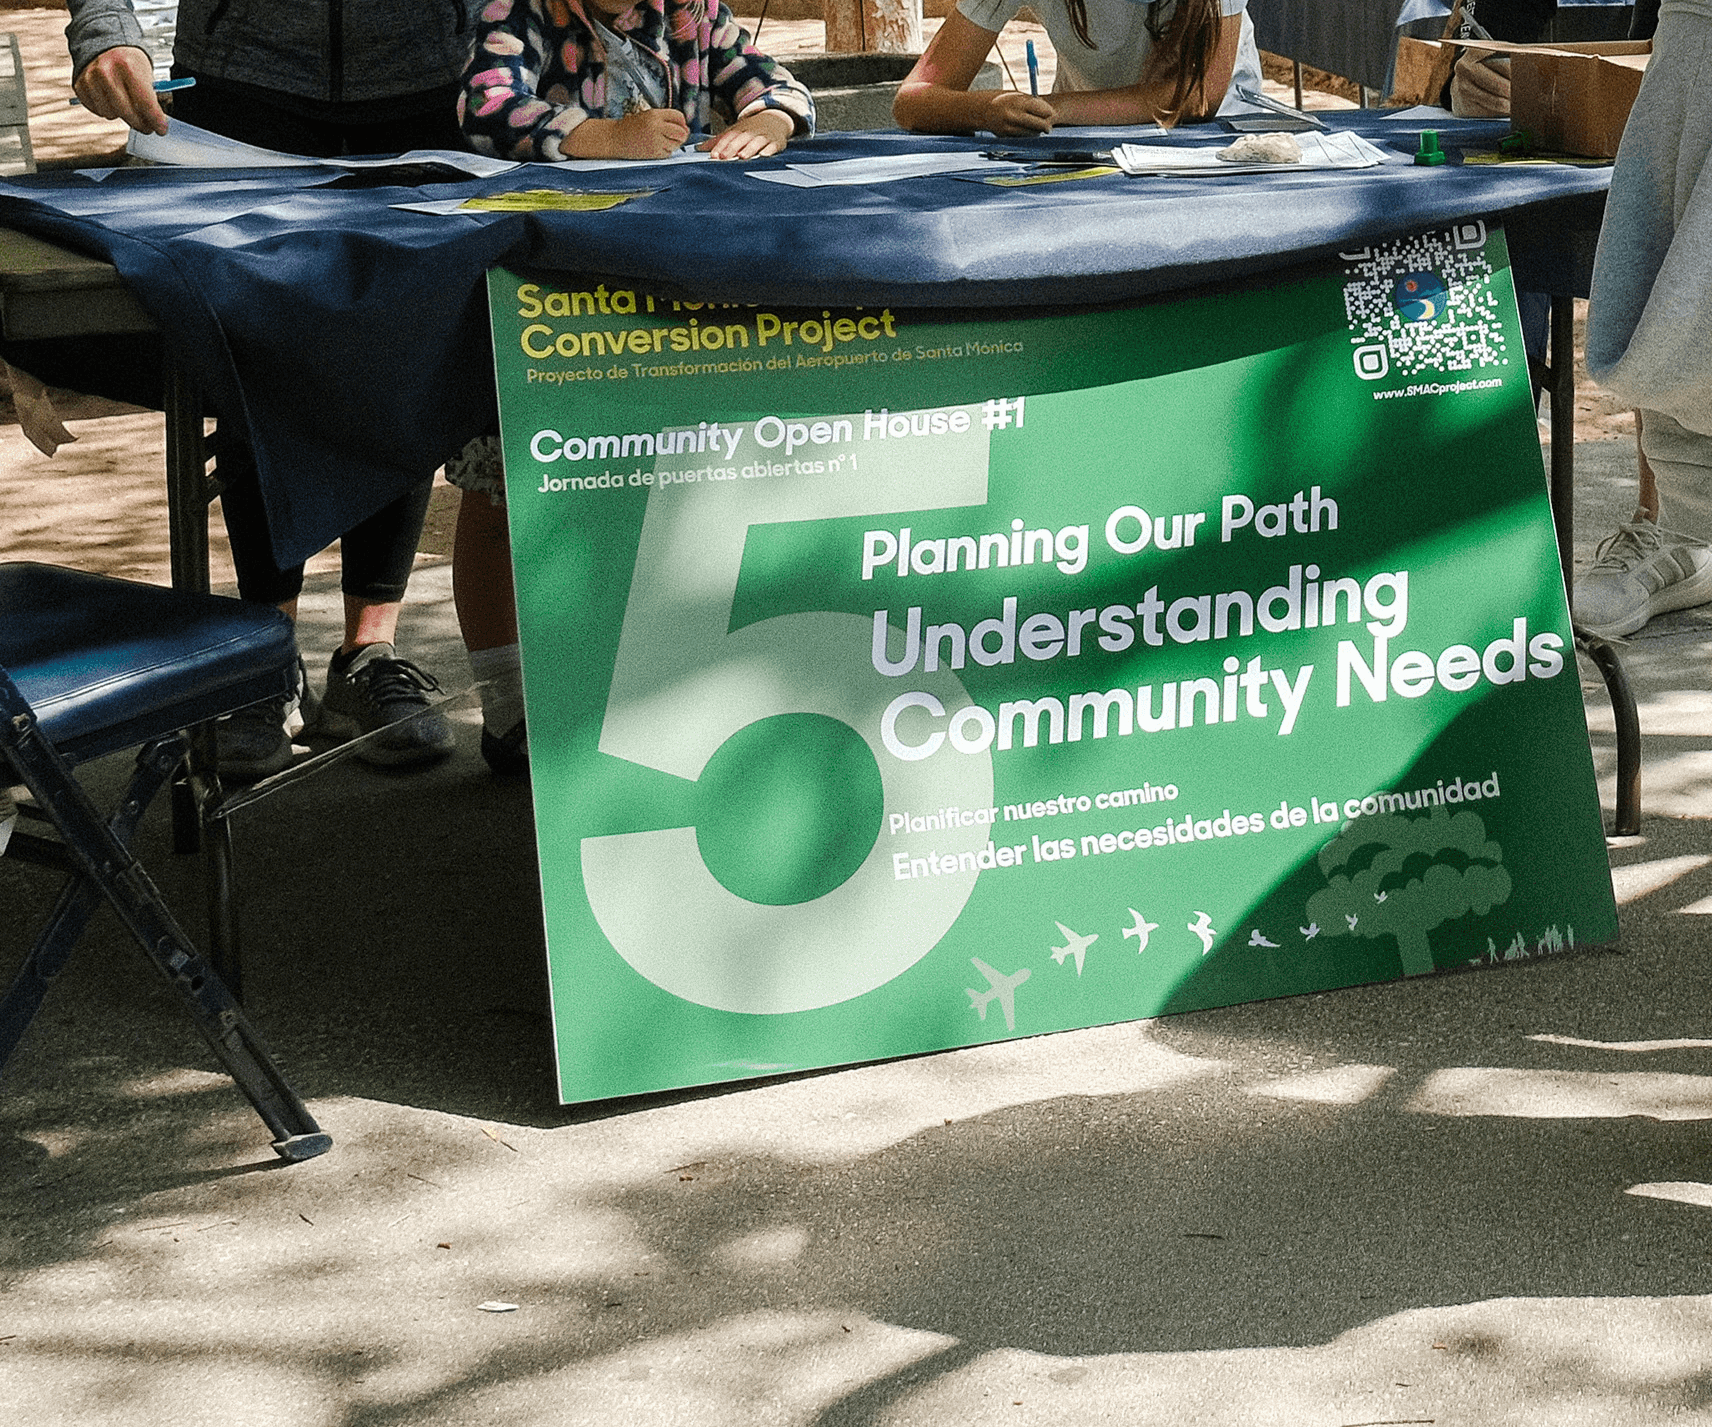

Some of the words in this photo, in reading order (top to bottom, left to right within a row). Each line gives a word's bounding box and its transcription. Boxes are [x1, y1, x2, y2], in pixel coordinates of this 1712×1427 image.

[516, 283, 637, 319] Santa
[520, 317, 749, 360] Conversion
[756, 308, 897, 353] Project
[526, 364, 603, 387] Proyecto
[607, 363, 629, 381] de
[632, 355, 764, 378] Transformación
[766, 353, 791, 372] del
[795, 348, 888, 373] Aeropuerto
[892, 345, 912, 362] de
[916, 341, 964, 361] Santa
[966, 338, 1024, 357] Mónica
[1372, 376, 1503, 401] www.SMACproject.com
[529, 420, 743, 465] Community
[754, 414, 854, 452] Open
[863, 405, 971, 441] House
[981, 397, 1026, 431] #1
[537, 471, 624, 494] Jornada
[627, 468, 654, 489] de
[658, 464, 737, 494] puertas
[741, 458, 825, 481] abiertas
[861, 518, 1090, 580] Planning
[1104, 504, 1206, 555] Our
[1220, 485, 1340, 543] Path
[870, 564, 1410, 678] Understanding
[880, 653, 1314, 762] Community
[1335, 616, 1565, 708] Needs
[889, 805, 999, 835] Planificar
[1003, 793, 1092, 822] nuestro
[1095, 781, 1179, 810] camino
[892, 841, 1028, 881] Entender
[1031, 834, 1077, 863] las
[1081, 809, 1266, 857] necesidades
[1269, 800, 1308, 830] de
[1311, 796, 1340, 824] la
[1343, 771, 1501, 816] comunidad
